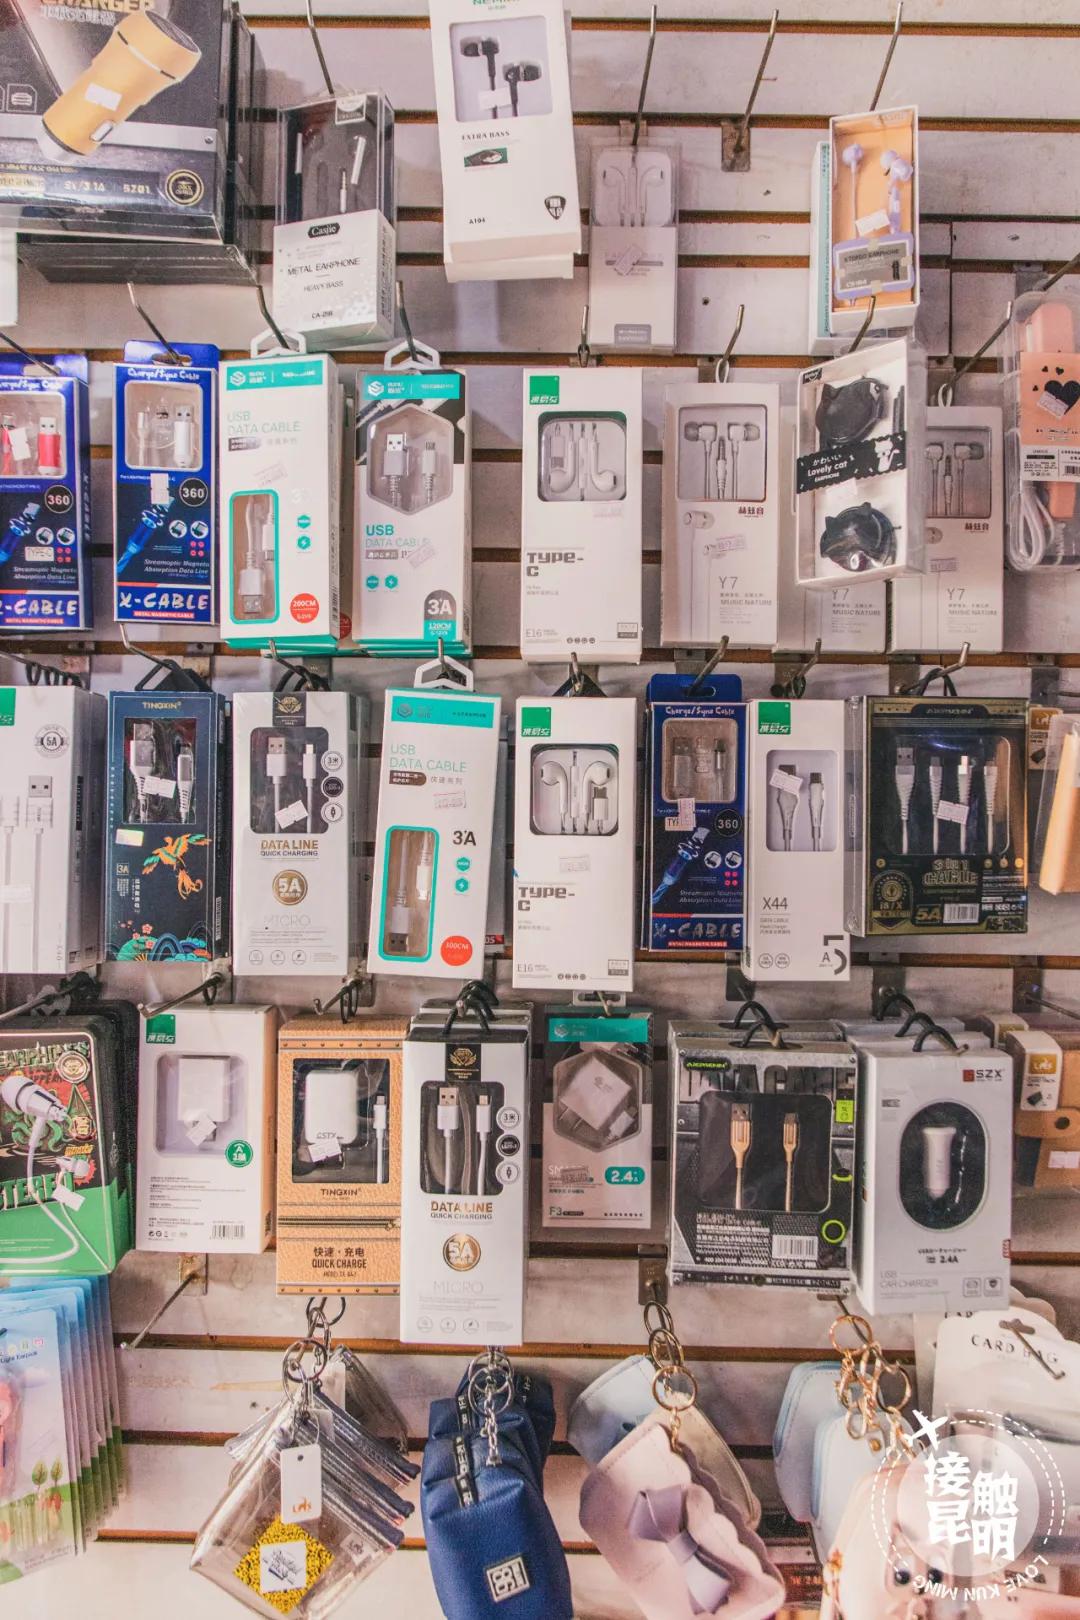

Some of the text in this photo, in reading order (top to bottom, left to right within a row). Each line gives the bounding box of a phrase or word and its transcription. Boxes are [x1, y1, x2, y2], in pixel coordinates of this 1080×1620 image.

[462, 132, 487, 141] EXTRA
[288, 257, 361, 275] METAL EARPHONE
[227, 410, 251, 421] USB
[227, 421, 301, 435] DATA CABLE
[808, 461, 848, 477] Lovely cat
[183, 487, 204, 498] 360
[48, 495, 70, 506] 360
[366, 524, 394, 536] USB
[365, 538, 393, 548] DATA
[0, 599, 78, 616] -CABLE
[427, 599, 453, 615] 3A
[390, 743, 416, 755] USB
[389, 757, 467, 772] DATA CABLE
[718, 820, 739, 829] 360
[452, 830, 477, 846] 3A
[261, 840, 318, 850] DATA LINE
[278, 877, 301, 893] 5A
[762, 897, 788, 911] X44
[976, 1069, 1002, 1078] SZX
[320, 1188, 358, 1196] TINGXIN
[431, 1201, 493, 1213] DATA LINE
[312, 1259, 367, 1268] QUICK CHARGE
[433, 1280, 484, 1293] MICRO
[971, 1334, 1015, 1353] CARD
